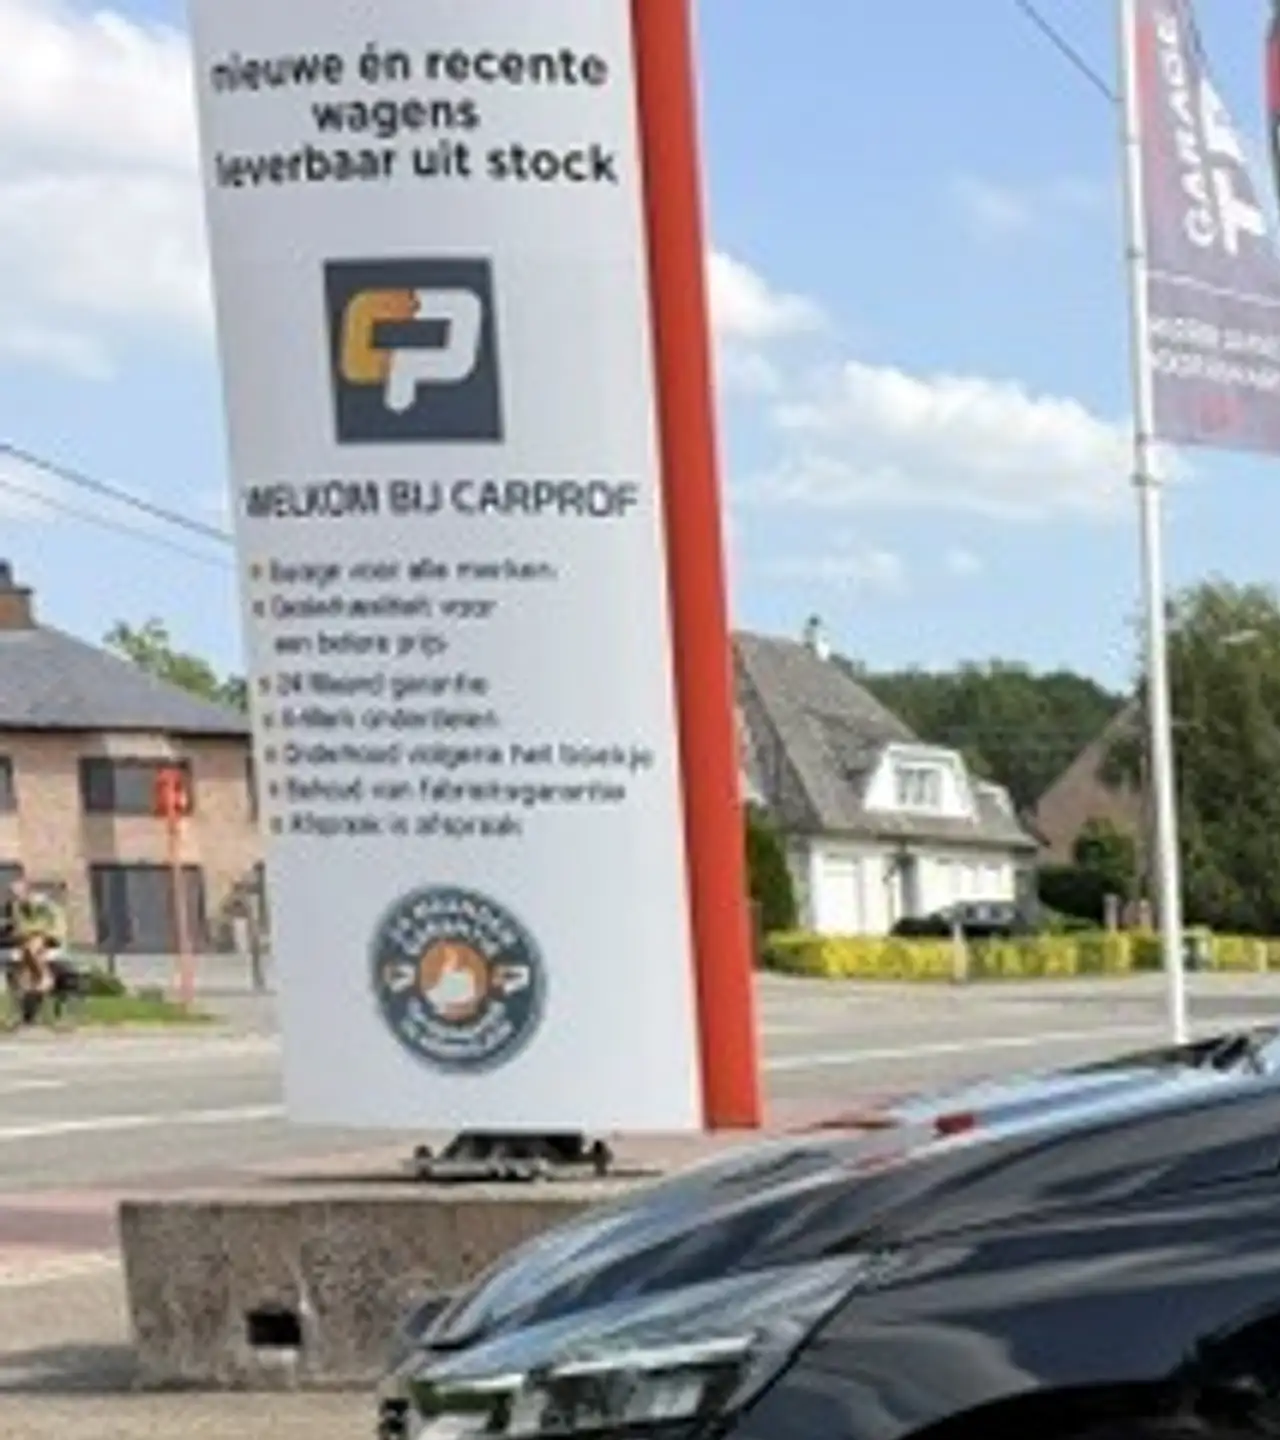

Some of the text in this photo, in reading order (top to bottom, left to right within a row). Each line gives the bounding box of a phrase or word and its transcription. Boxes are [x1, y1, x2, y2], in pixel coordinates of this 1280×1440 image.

[211, 42, 608, 92] nieuwe én recente
[312, 98, 480, 139] wagens
[215, 140, 618, 187] leverbaar uit stock
[246, 480, 380, 518] WELKOM
[450, 478, 638, 517] CARPROF
